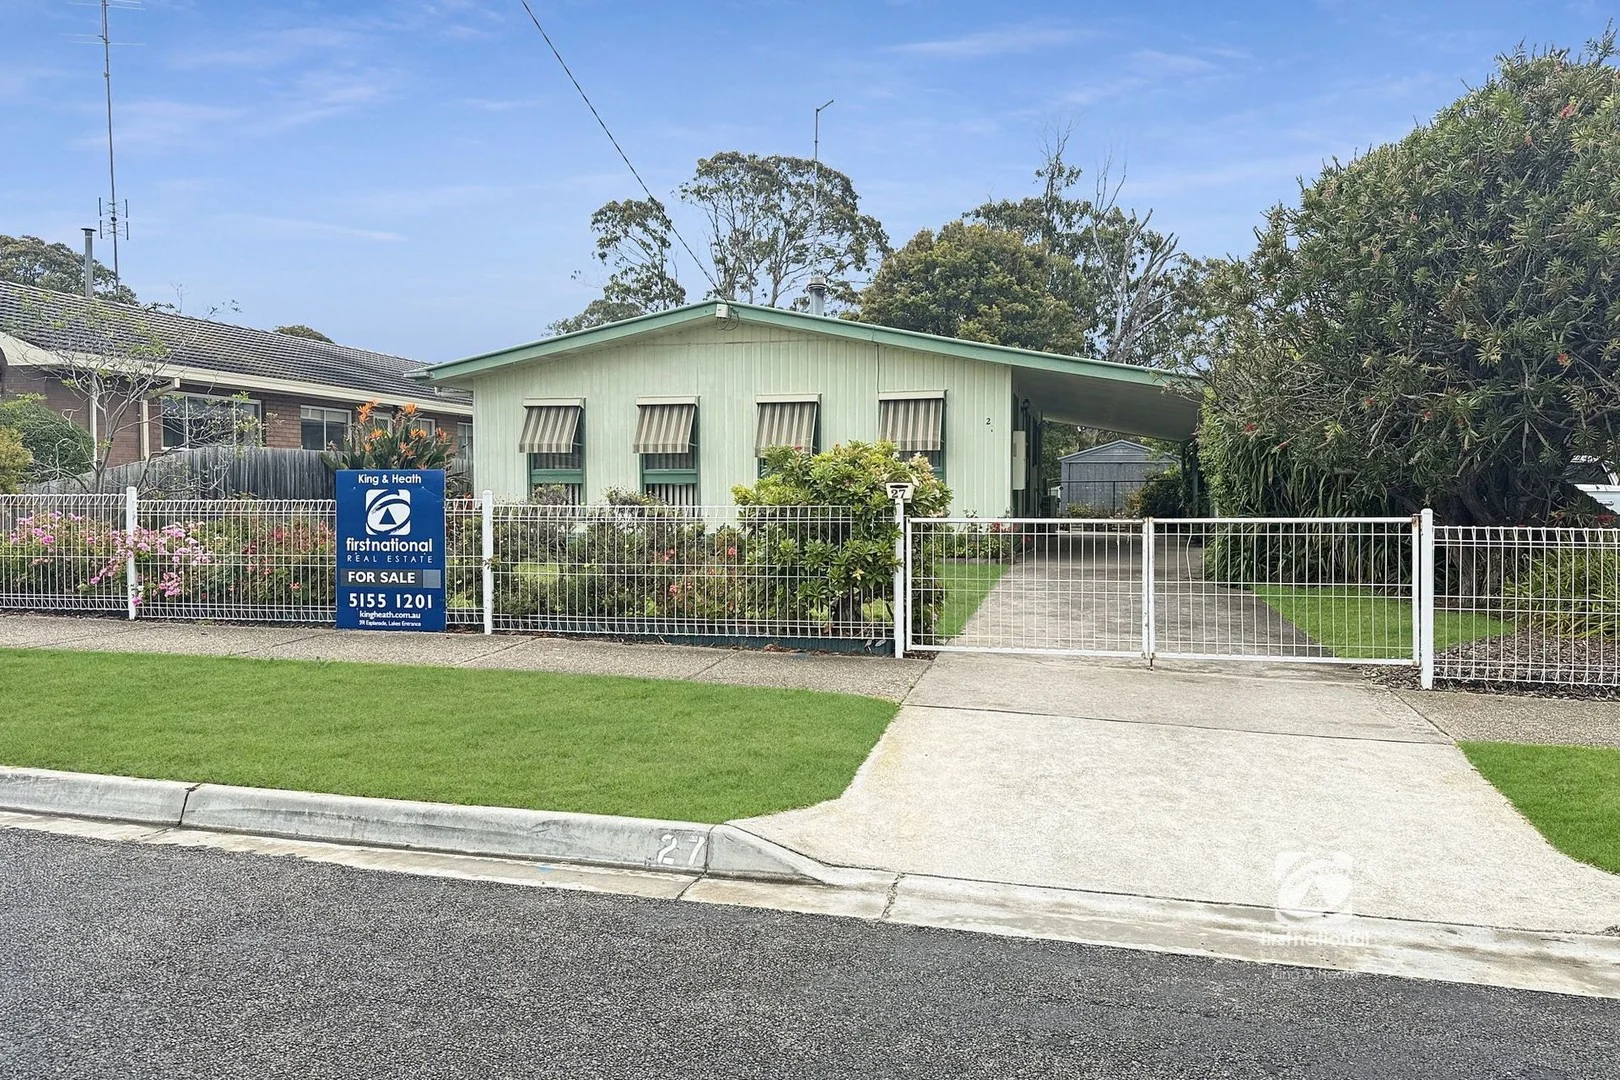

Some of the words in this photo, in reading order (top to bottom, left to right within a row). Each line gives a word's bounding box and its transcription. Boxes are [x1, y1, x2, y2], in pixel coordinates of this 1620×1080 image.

[358, 474, 379, 485] King
[382, 474, 389, 484] &
[392, 474, 422, 484] Heath
[891, 489, 906, 499] 27
[346, 537, 433, 552] firstnational
[347, 554, 378, 563] REAL
[387, 555, 433, 564] ESTATE
[348, 571, 375, 583] FOR
[380, 572, 416, 584] SALE
[349, 592, 387, 608] 5155
[396, 594, 433, 609] 1201
[359, 610, 421, 619] kingheath.com.au
[657, 833, 706, 866] 27
